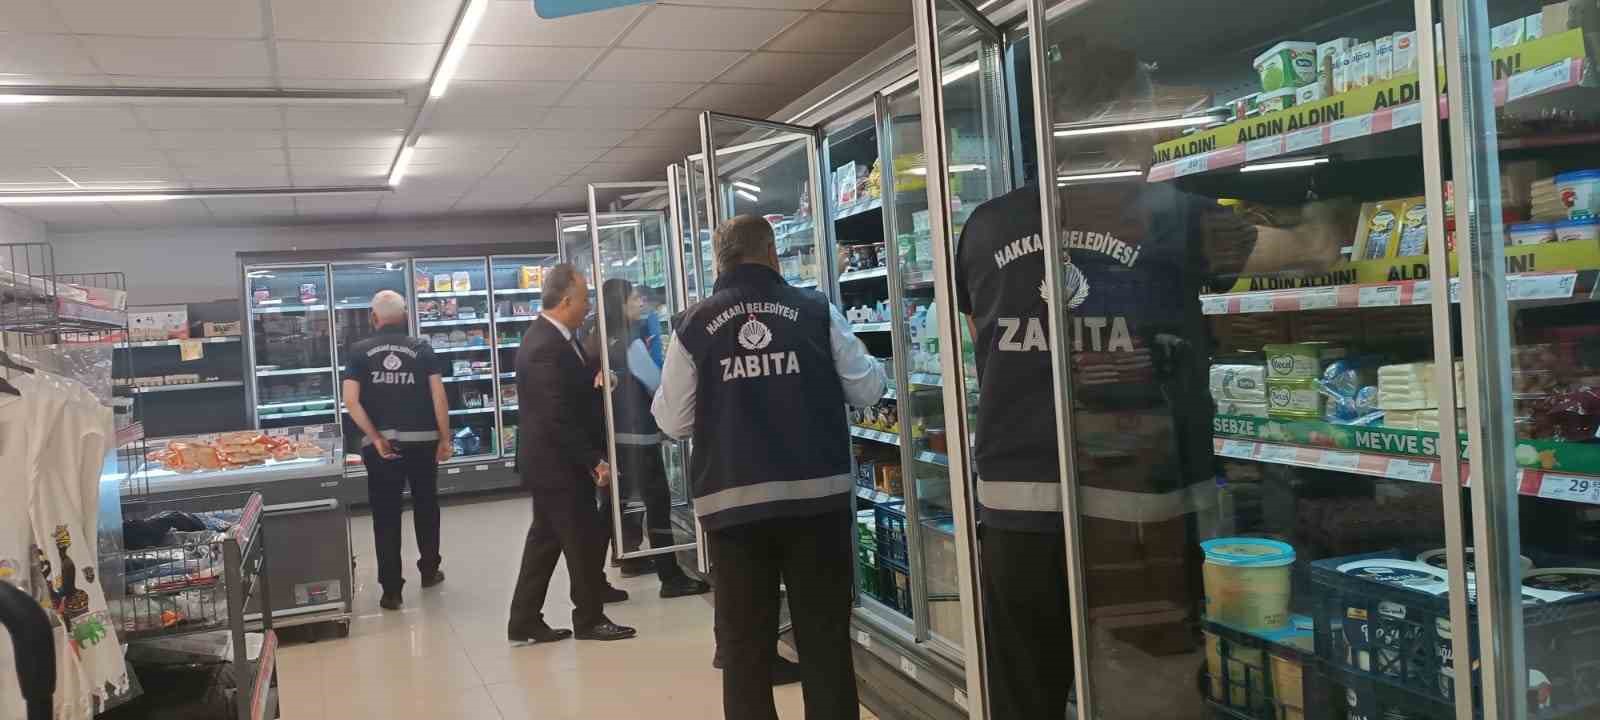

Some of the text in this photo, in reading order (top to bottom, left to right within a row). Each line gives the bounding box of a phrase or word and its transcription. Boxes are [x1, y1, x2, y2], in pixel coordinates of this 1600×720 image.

[1374, 81, 1420, 110] ALDI
[1236, 101, 1345, 144] ALDIN ALDIN!
[1174, 134, 1216, 158] ALDIN!
[994, 230, 1141, 269] HAKKA BELEDİYESİ
[1250, 268, 1357, 291] ALDIN ALDIN!
[706, 302, 800, 335] HAKKARİ BELEDİYESİ
[998, 317, 1134, 352] ZAITA
[371, 371, 415, 384] ZABITA
[720, 351, 800, 382] ZABITA
[1213, 418, 1255, 436] SEBZE
[1355, 431, 1418, 454] MEYVE
[1568, 479, 1589, 493] 29
